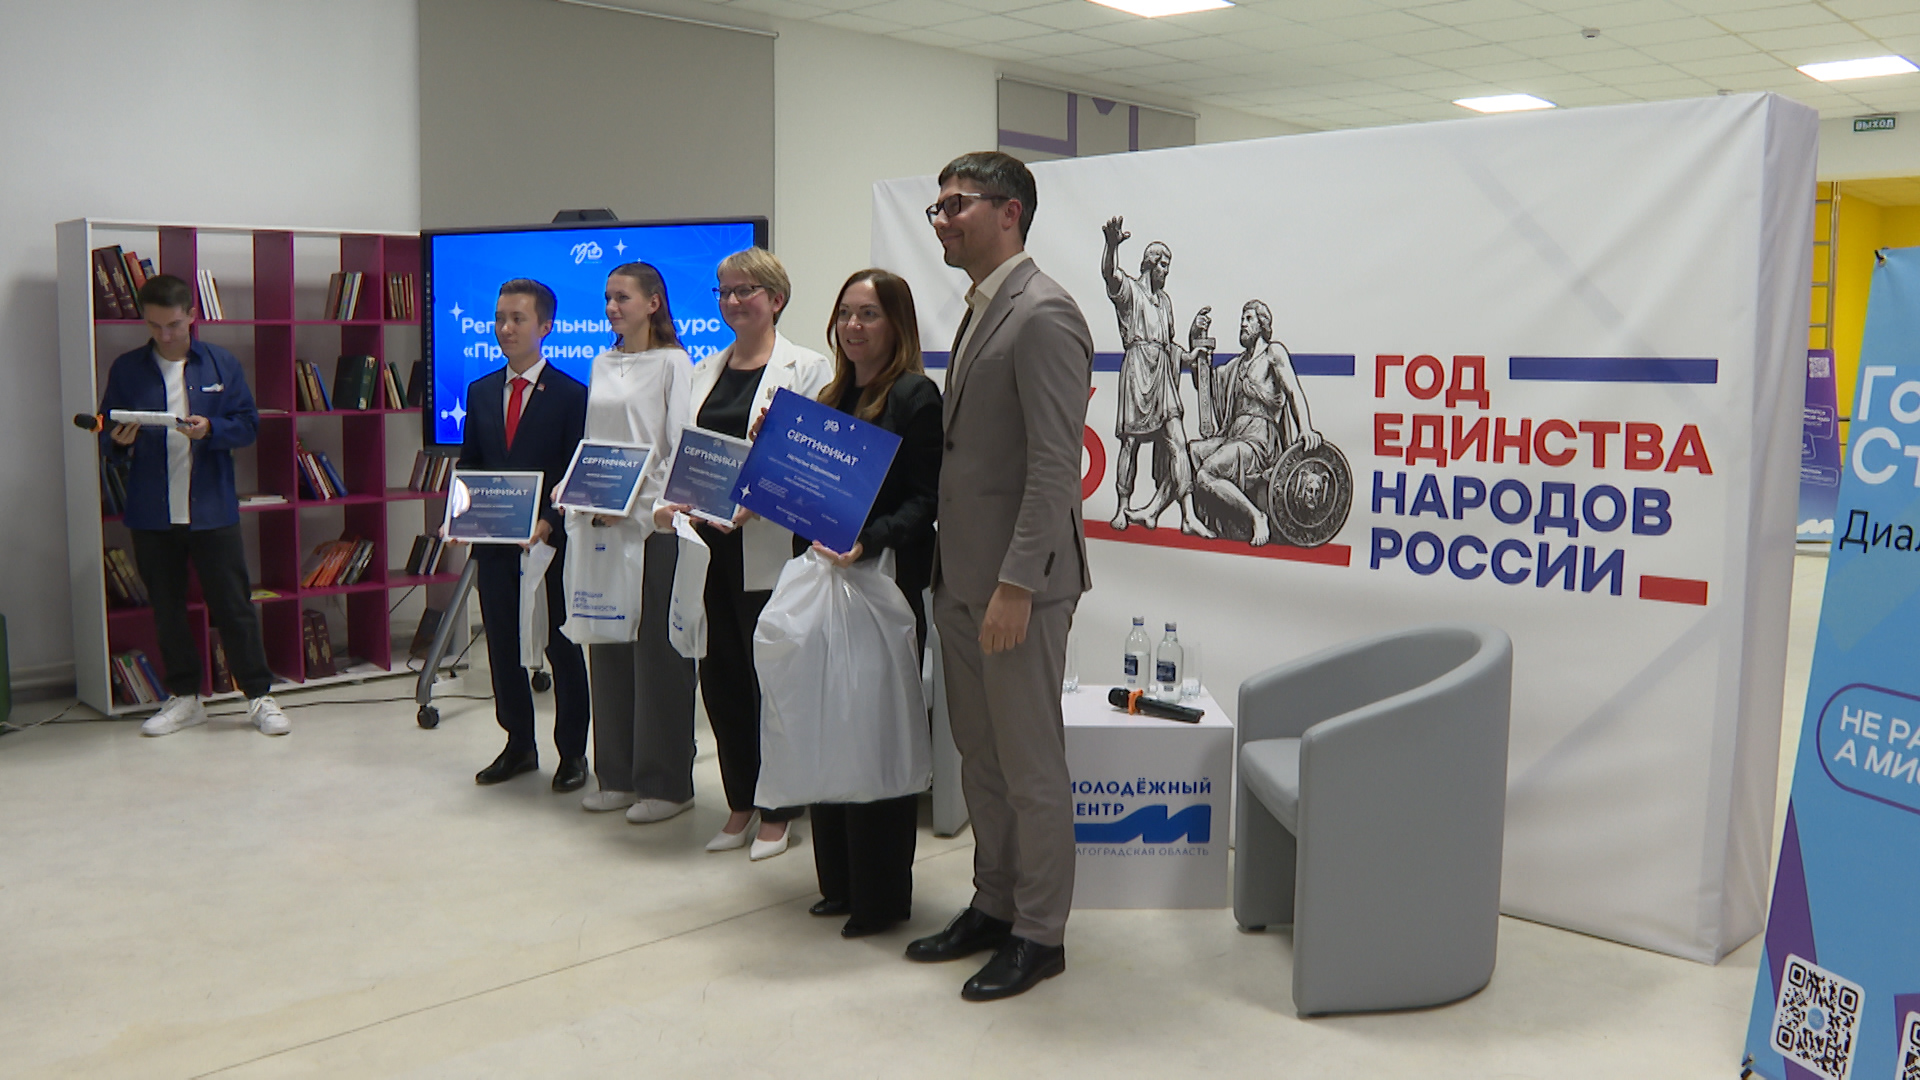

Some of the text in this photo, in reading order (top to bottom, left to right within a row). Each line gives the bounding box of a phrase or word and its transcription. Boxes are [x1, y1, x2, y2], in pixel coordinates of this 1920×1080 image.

[1856, 118, 1894, 130] ВЫХОД
[462, 316, 613, 334] Регльный
[463, 342, 594, 362] «Прание
[1375, 354, 1490, 410] ГОД
[787, 429, 859, 466] СЕРТИФИКАТ
[1373, 412, 1714, 475] ЕДИНСТВА
[469, 487, 529, 496] ЕРТИФИКАТ
[1371, 470, 1673, 538] НАРОДОВ
[1839, 509, 1920, 553] Диа
[1370, 527, 1625, 596] РОССИИ
[1840, 705, 1882, 740] НЕ
[1834, 738, 1920, 785] А МИ
[1076, 803, 1125, 816] ЕНТР
[1158, 847, 1209, 857] ОБЛАСТЬ
